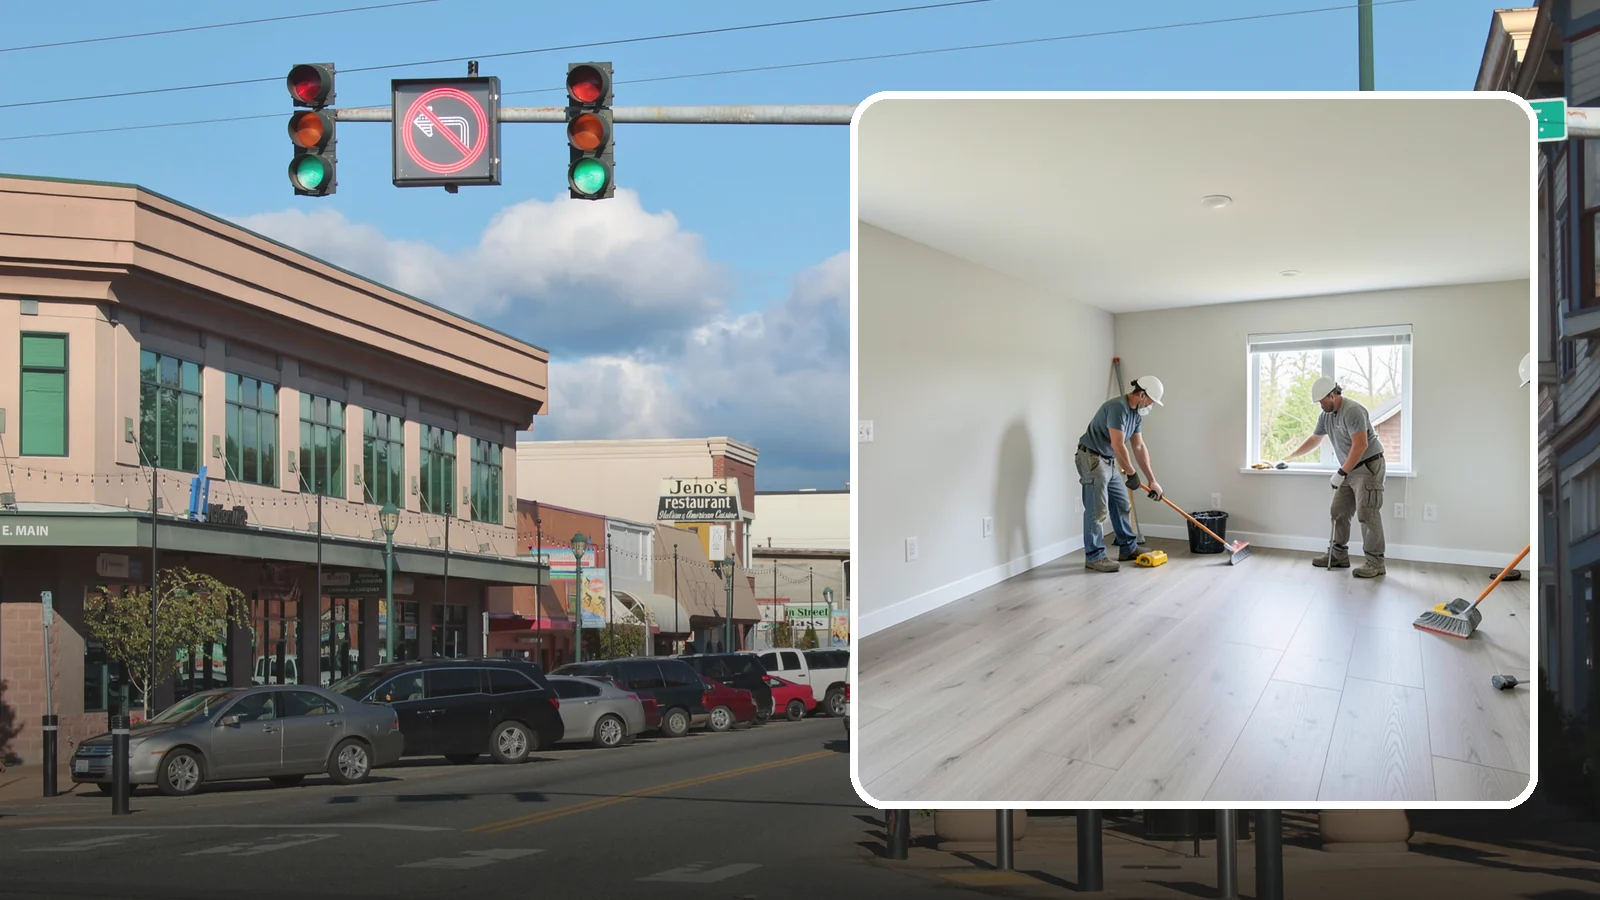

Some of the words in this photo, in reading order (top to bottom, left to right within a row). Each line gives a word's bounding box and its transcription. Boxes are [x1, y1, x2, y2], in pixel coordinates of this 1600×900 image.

[670, 480, 727, 494] Jeno's
[665, 496, 731, 509] restaurant
[659, 510, 682, 519] Italian
[686, 510, 714, 519] American
[715, 510, 738, 519] Cuisine
[2, 525, 13, 536] E.
[16, 525, 48, 536] MAIN
[797, 608, 828, 616] Street
